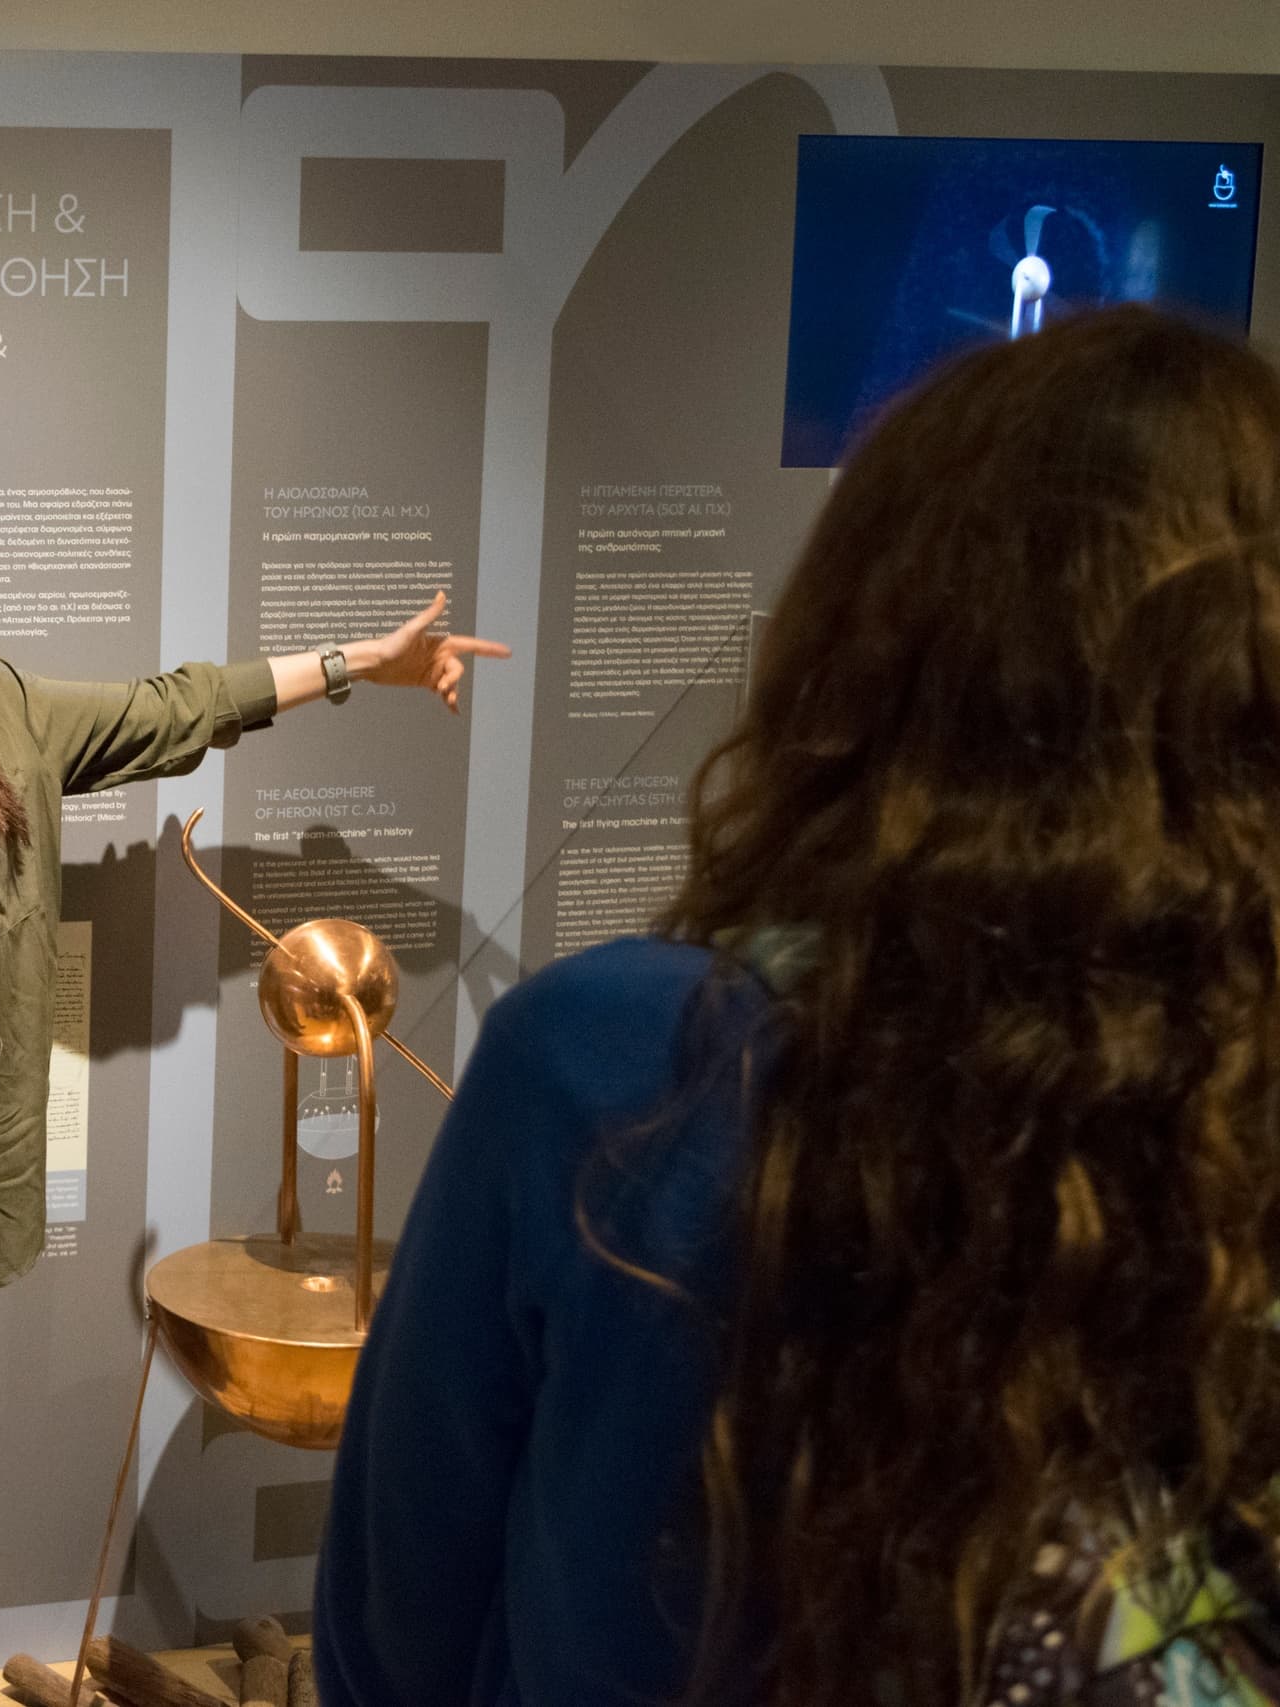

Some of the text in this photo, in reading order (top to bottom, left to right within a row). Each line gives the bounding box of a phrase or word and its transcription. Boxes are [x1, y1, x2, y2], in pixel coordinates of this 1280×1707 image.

[54, 194, 85, 233] &
[264, 487, 368, 499] Η ΑΙΟΛΟΣΦΑΙΡΑ
[581, 488, 590, 497] Η
[659, 485, 722, 497] ΠΕΡΙΣΤΕΡΑ
[264, 507, 290, 519] ΤΟΥ
[294, 506, 349, 518] ΗΡΩΝΟΣ
[581, 505, 603, 515] ΤΟΥ
[272, 531, 301, 542] πρώτη
[304, 531, 370, 541] «ατμομηχανή»
[373, 532, 388, 541] της
[392, 531, 431, 541] ιστορίας
[579, 529, 585, 538] Η
[566, 779, 586, 790] THE
[634, 776, 678, 788] PIGEON
[256, 786, 375, 801] THE AEOLOSPHERE
[564, 796, 579, 808] OF
[584, 794, 648, 808] ARCHYTAS
[255, 808, 272, 820] OF
[277, 806, 321, 818] HERON
[563, 820, 577, 829] The
[596, 819, 620, 828] flying
[621, 818, 658, 826] machine
[255, 832, 270, 841] The
[273, 831, 288, 840] first
[374, 828, 382, 836] in
[384, 827, 414, 837] history
